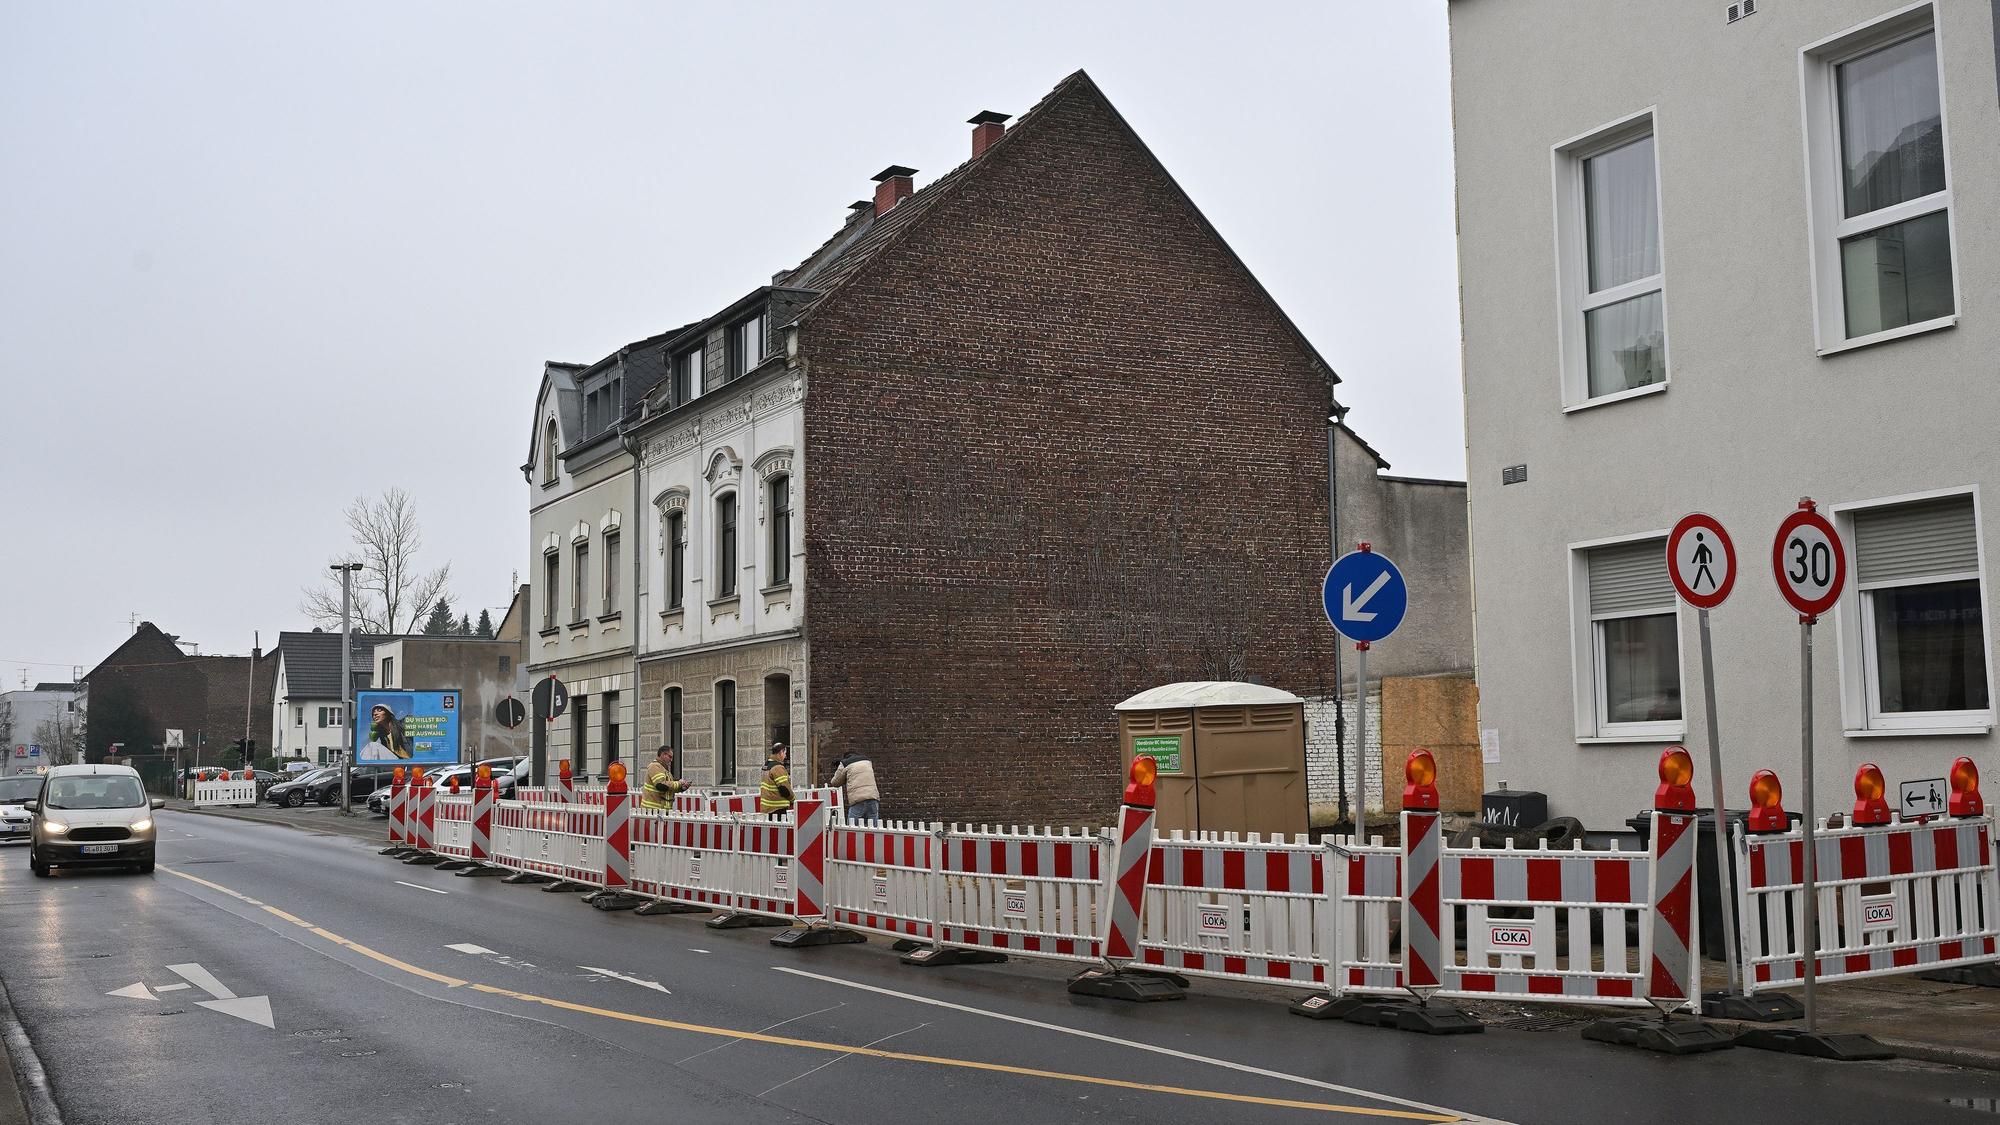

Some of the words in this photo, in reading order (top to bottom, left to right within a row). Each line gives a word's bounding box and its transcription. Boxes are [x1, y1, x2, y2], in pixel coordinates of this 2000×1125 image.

[1789, 538, 1830, 587] 30
[1867, 905, 1891, 920] LÖKA
[1495, 928, 1528, 943] LÖKA
